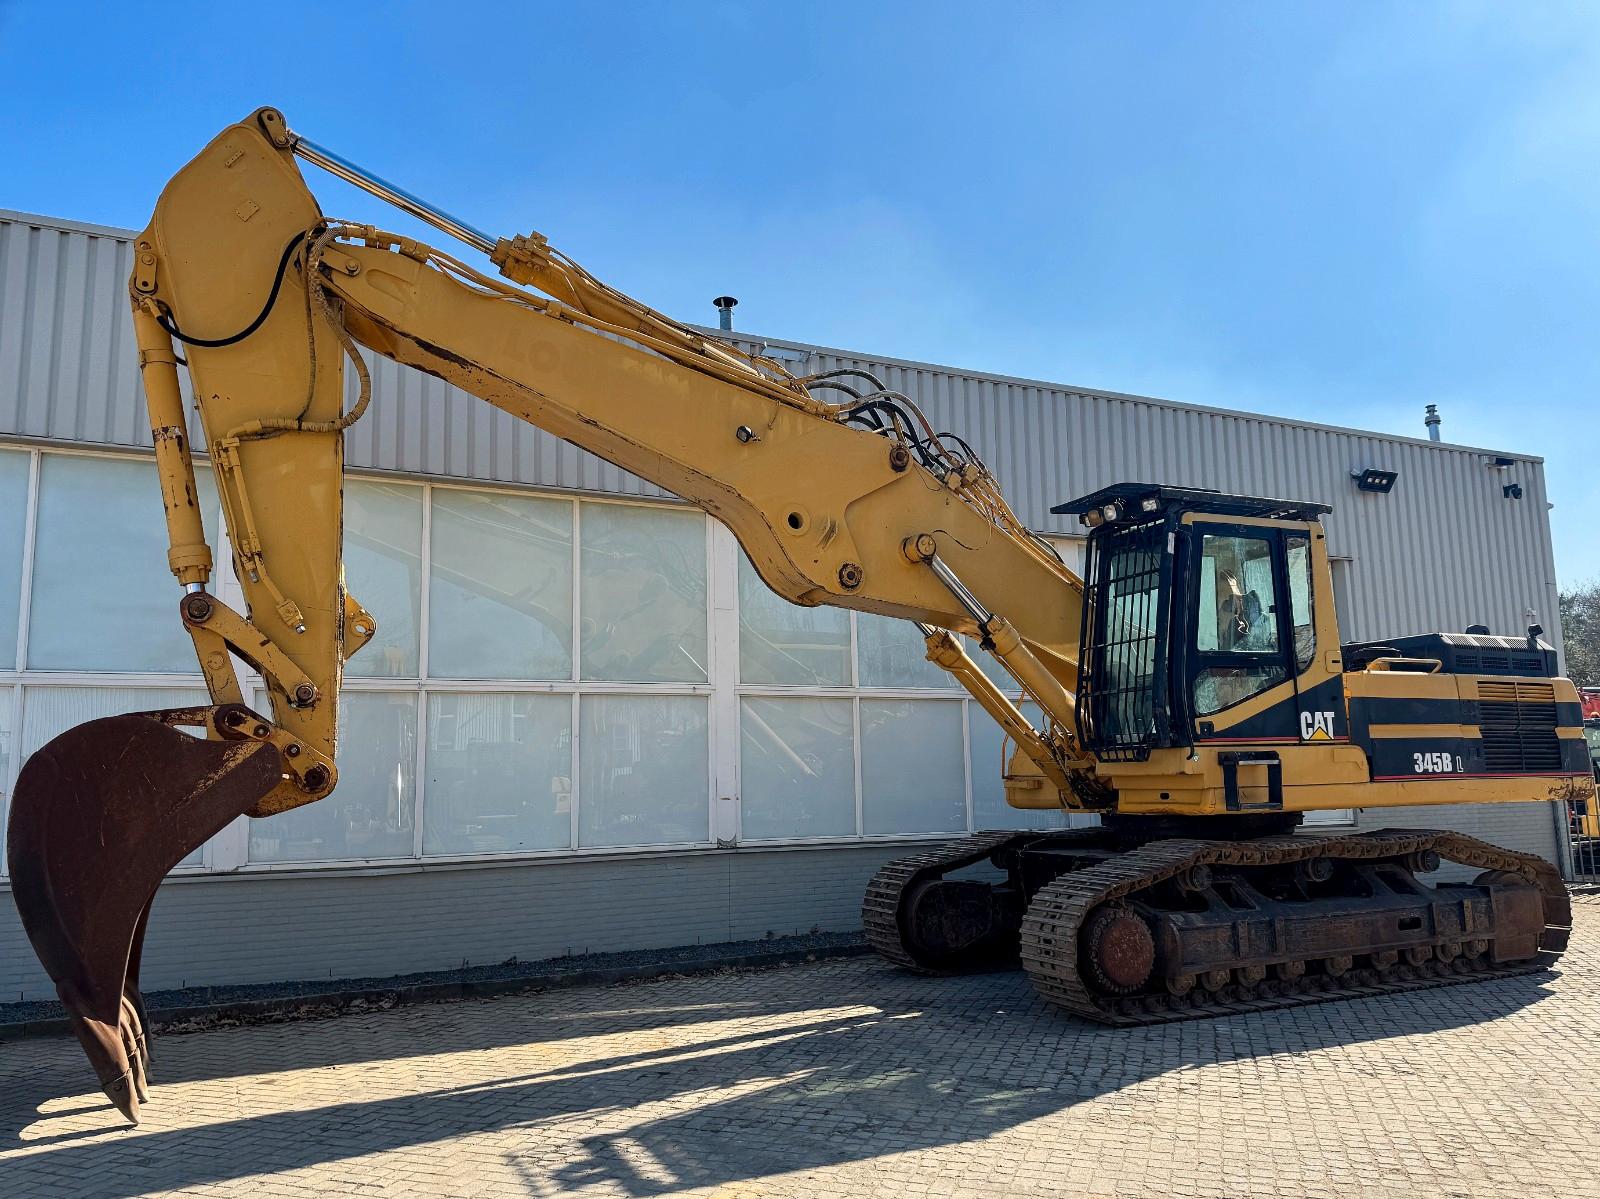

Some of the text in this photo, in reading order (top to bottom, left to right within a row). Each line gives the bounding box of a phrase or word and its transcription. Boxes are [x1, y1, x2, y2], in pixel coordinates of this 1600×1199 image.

[1300, 711, 1335, 740] CAT
[1413, 752, 1464, 773] 345B L
